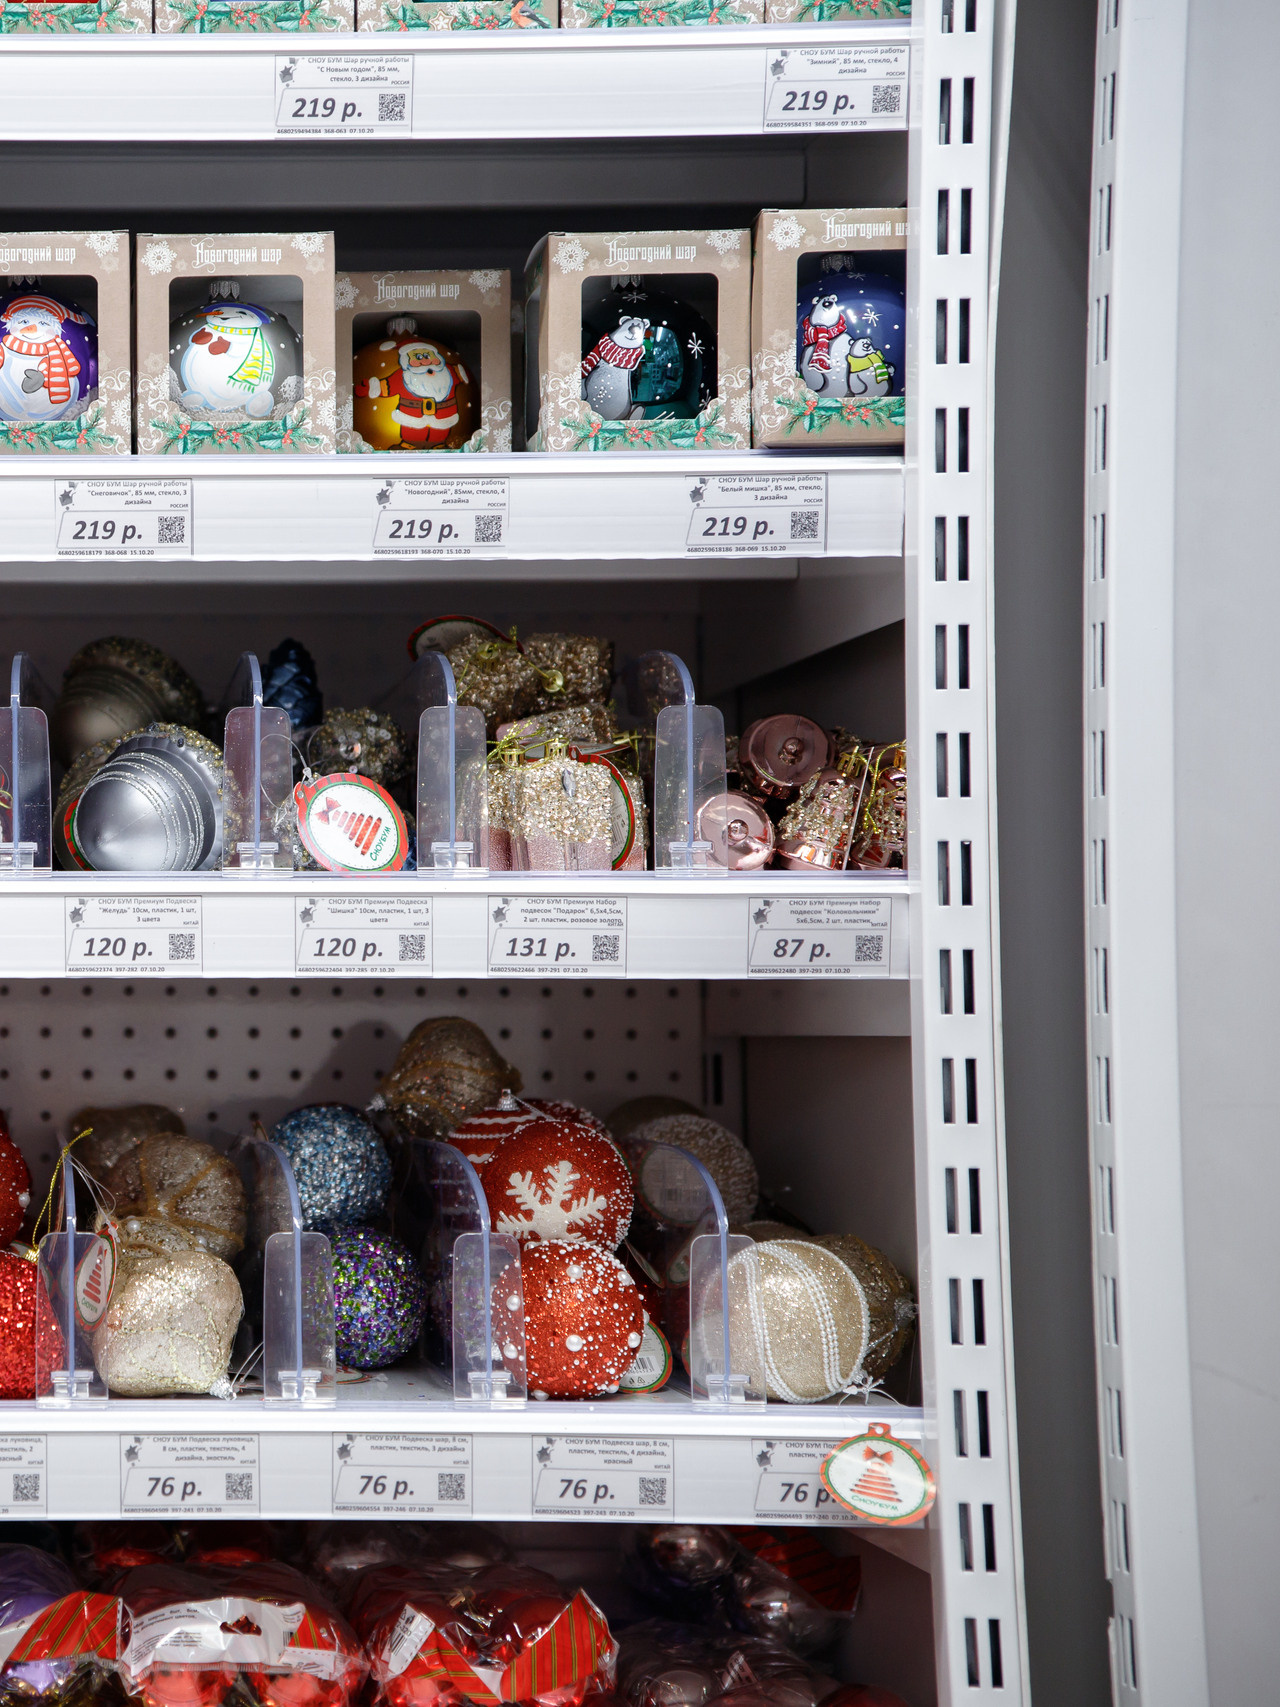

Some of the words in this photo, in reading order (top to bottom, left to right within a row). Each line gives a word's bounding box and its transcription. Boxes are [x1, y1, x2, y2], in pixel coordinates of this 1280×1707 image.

[292, 98, 335, 117] 219
[341, 103, 362, 122] р.
[782, 90, 827, 111] 219
[833, 95, 854, 115] р.
[820, 211, 892, 248] Новогодний
[895, 222, 916, 236] ша
[55, 248, 76, 264] шар
[191, 238, 258, 273] Новогодний
[260, 248, 282, 266] шар
[604, 238, 671, 273] Новогодний
[675, 247, 696, 265] шар
[372, 276, 437, 309] Новогодний
[440, 284, 460, 301] шар
[139, 480, 162, 488] ручной
[73, 521, 115, 539] 219
[122, 525, 142, 544] р.
[389, 519, 432, 538] 219
[438, 524, 458, 543] р.
[702, 517, 747, 536] 219
[753, 521, 774, 540] р.
[369, 826, 392, 862] СНОУБУМ
[84, 938, 126, 956] 120
[132, 942, 152, 961] р.
[314, 938, 356, 957] 120
[362, 943, 382, 961] р.
[506, 938, 546, 956] 131
[555, 943, 575, 961] р.
[774, 939, 804, 957] 87
[809, 943, 830, 962] р.
[148, 1477, 175, 1496] 76
[181, 1482, 201, 1501] р.
[360, 1476, 387, 1495] 76
[393, 1481, 414, 1500] р.
[559, 1479, 587, 1498] 76
[593, 1485, 614, 1504] р.
[780, 1483, 808, 1502] 76
